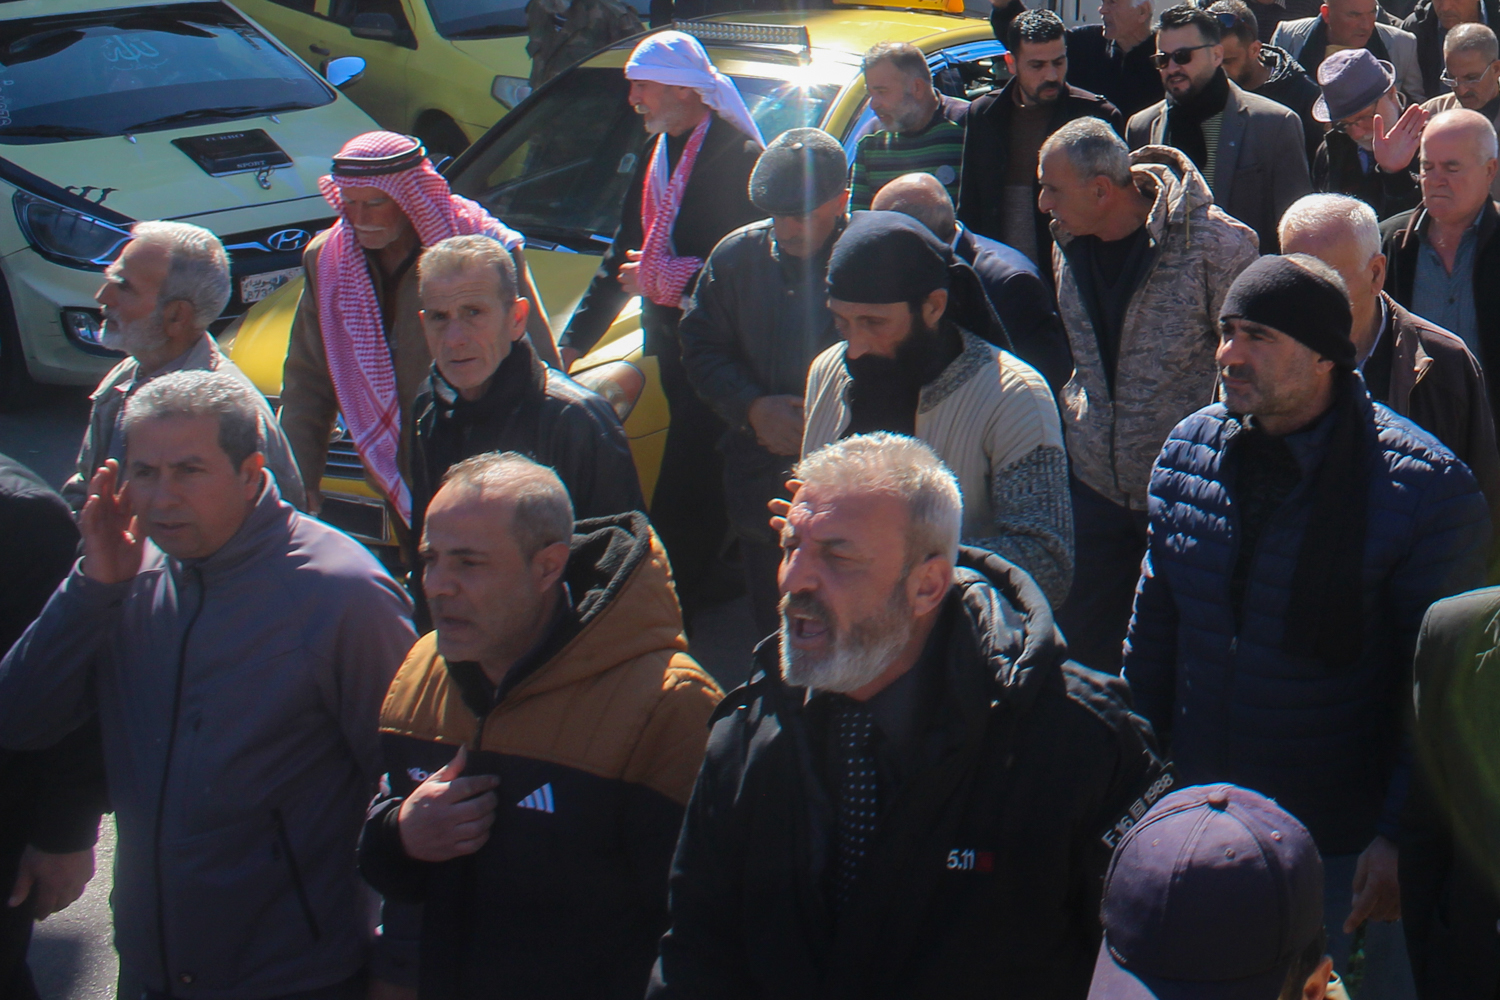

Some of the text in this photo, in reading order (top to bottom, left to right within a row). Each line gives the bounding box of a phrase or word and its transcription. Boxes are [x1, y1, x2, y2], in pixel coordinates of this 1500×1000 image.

[236, 159, 267, 170] SPORT
[1143, 773, 1175, 806] 1988
[946, 848, 976, 871] 5.11
